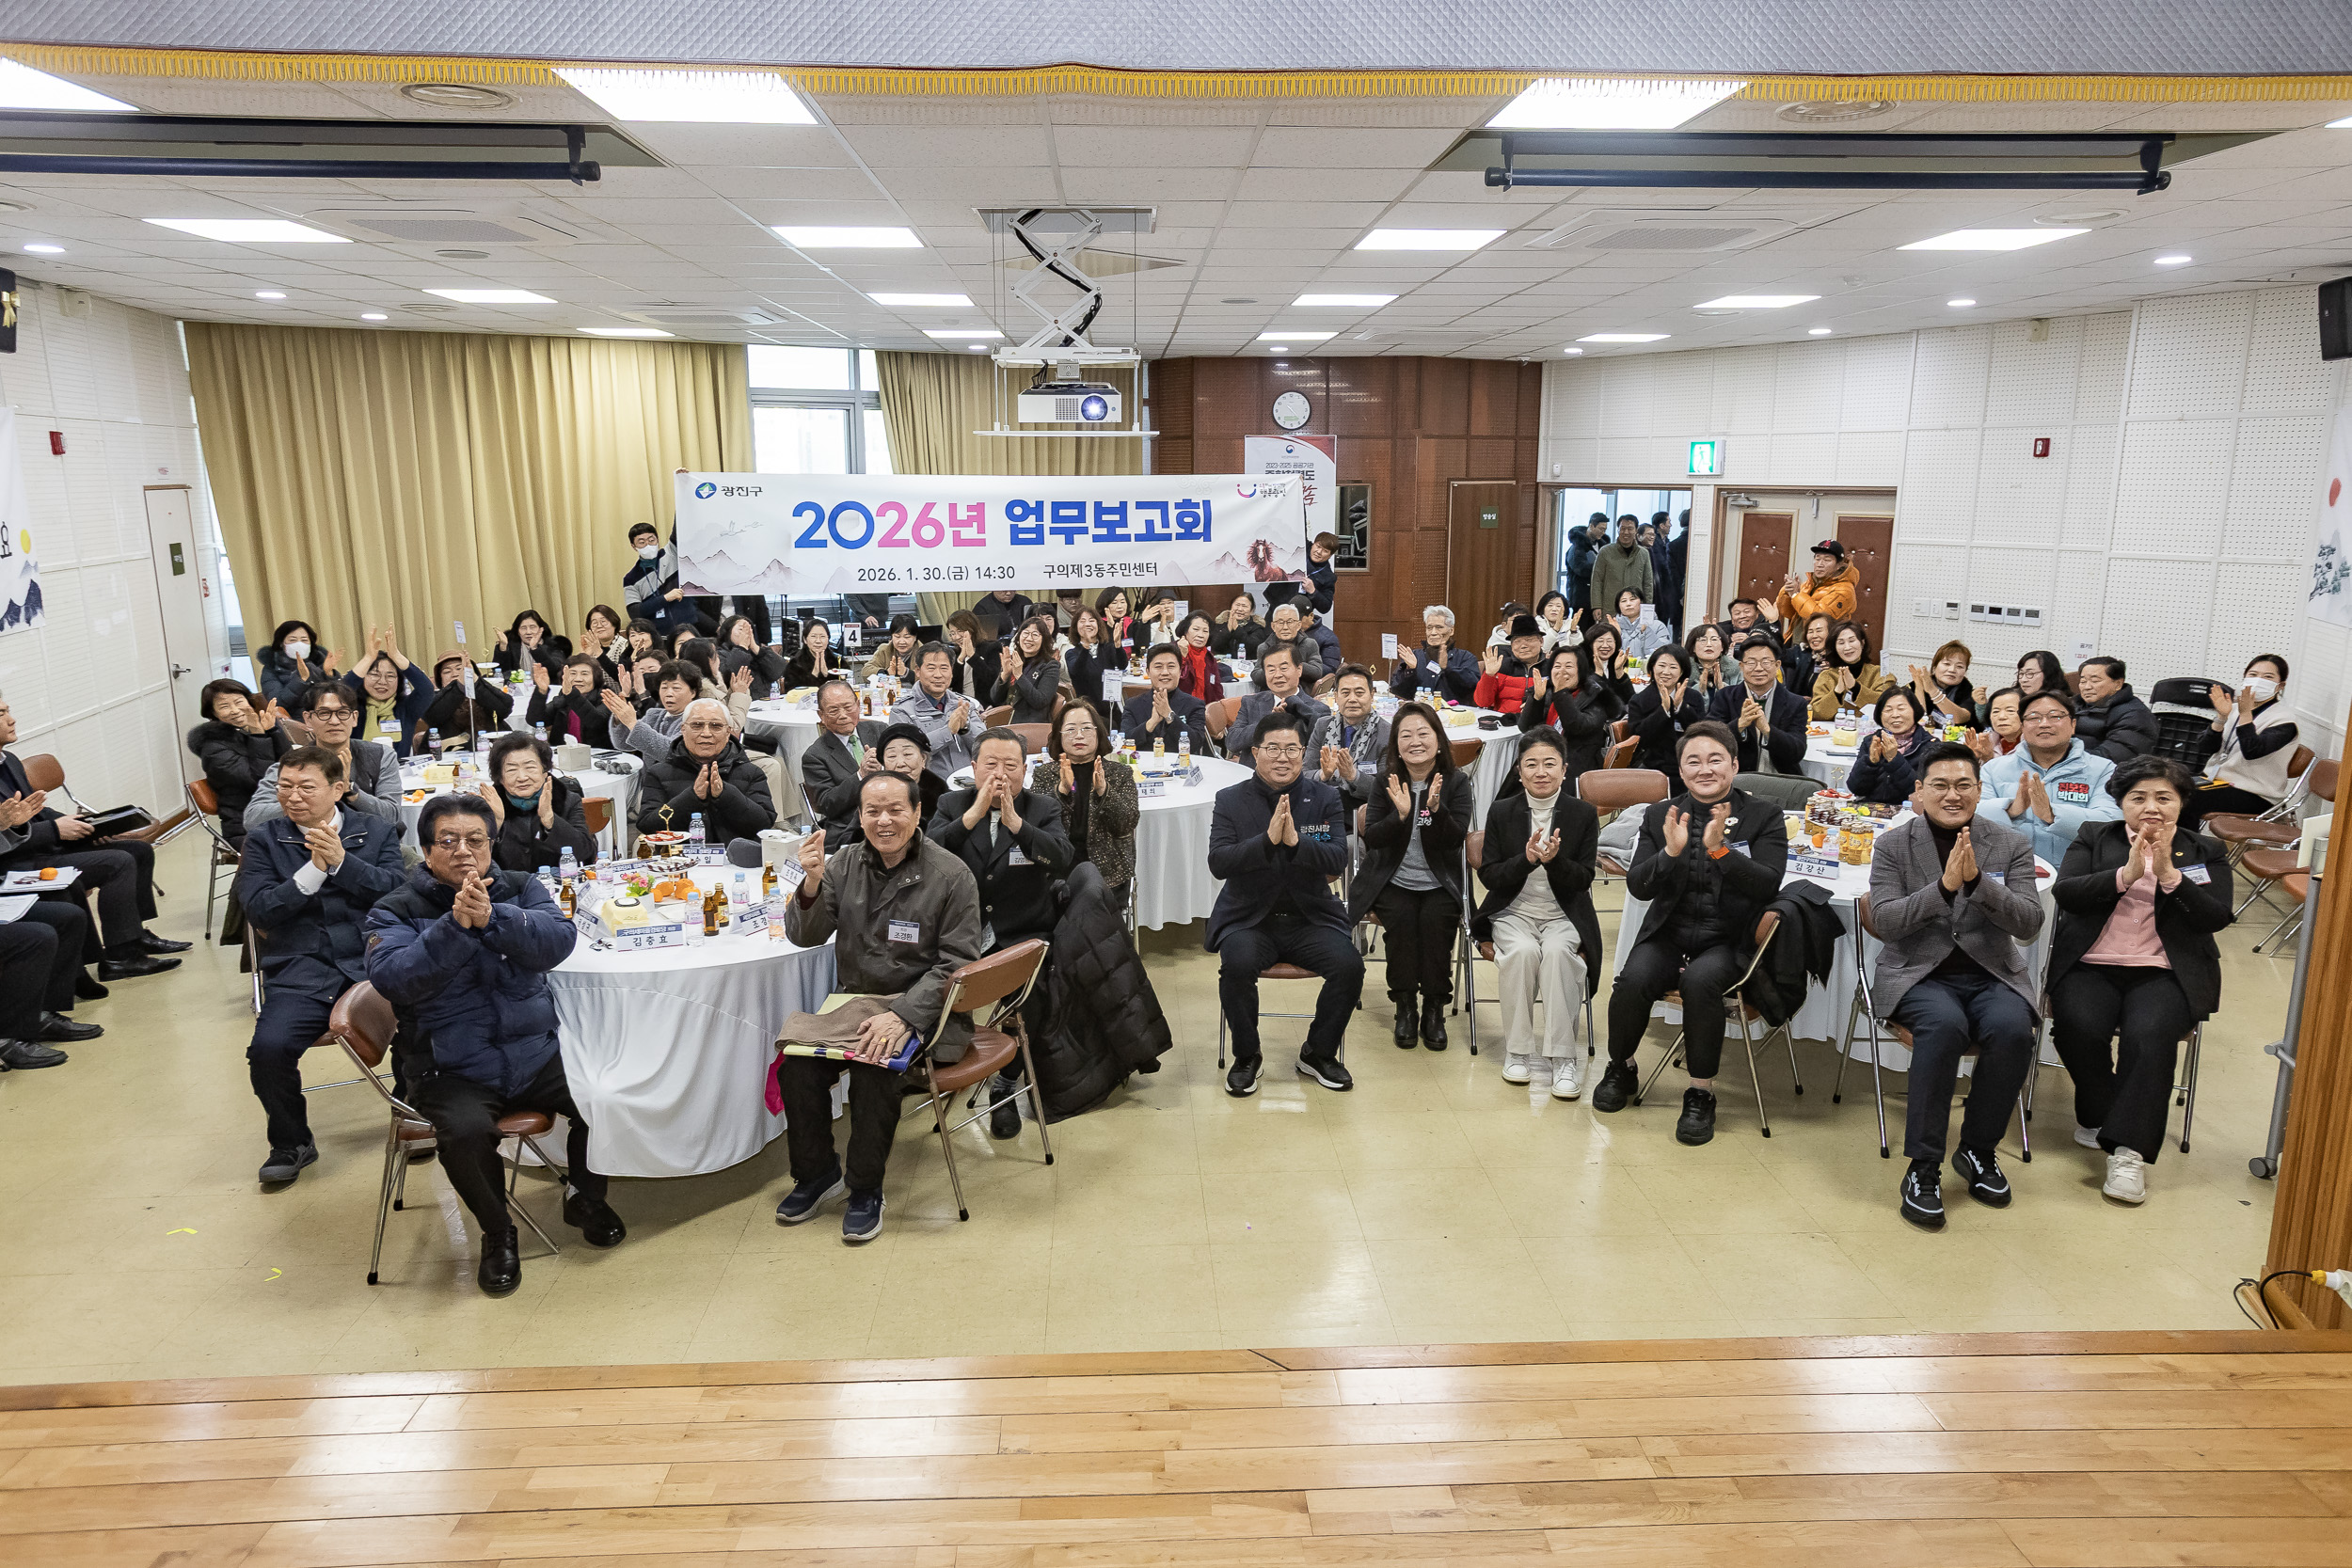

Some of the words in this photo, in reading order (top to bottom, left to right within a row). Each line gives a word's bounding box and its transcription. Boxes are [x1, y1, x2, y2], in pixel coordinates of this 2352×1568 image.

[721, 485, 763, 498] 광진구
[792, 500, 987, 551] 2026년
[1005, 499, 1212, 546] 업무보고회
[857, 567, 901, 582] 2026.
[906, 567, 919, 581] 1.
[922, 566, 969, 582] 30.(금)
[975, 566, 1015, 580] 14:30
[1042, 562, 1158, 579] 구의제3동주민센터
[848, 630, 858, 643] 4
[2058, 791, 2089, 802] 박대희
[893, 931, 914, 942] 조경환
